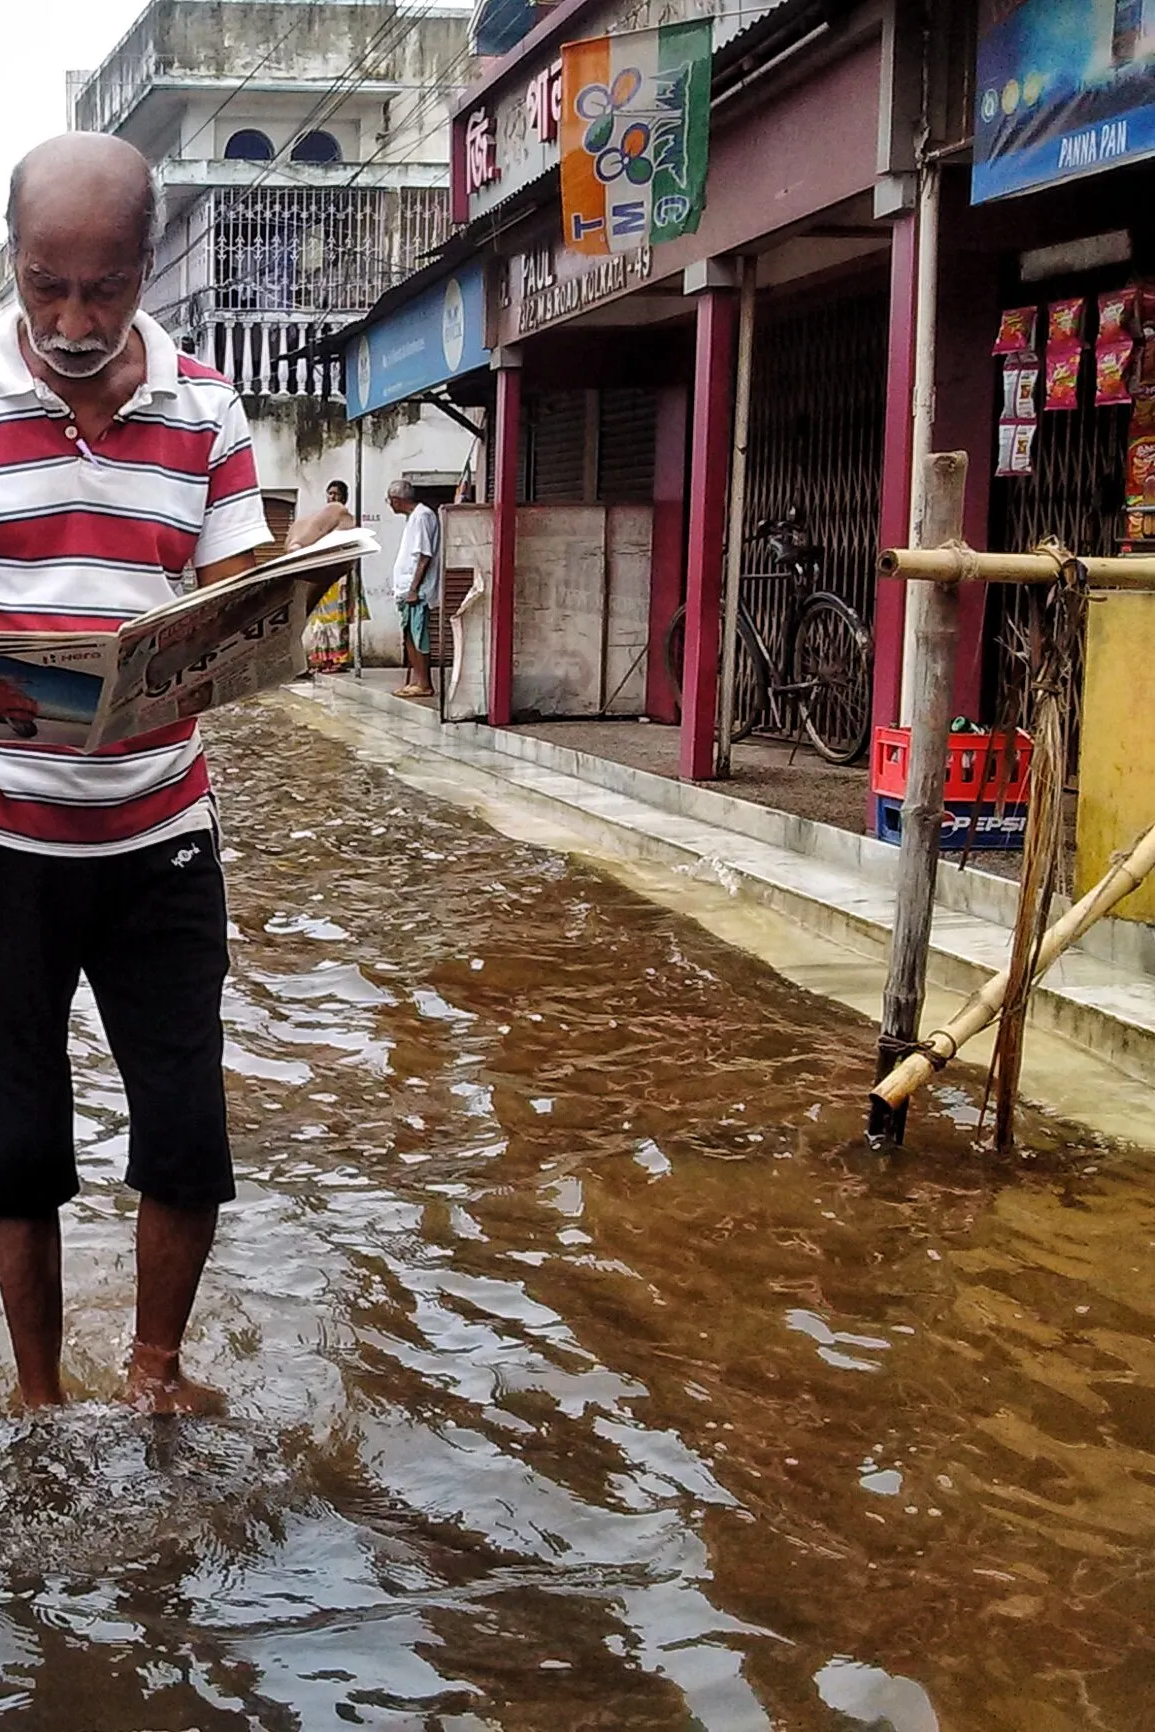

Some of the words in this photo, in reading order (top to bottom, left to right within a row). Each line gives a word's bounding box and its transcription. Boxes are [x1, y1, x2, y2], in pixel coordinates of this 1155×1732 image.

[1058, 129, 1097, 169] PANNA
[1099, 120, 1127, 161] PAN
[520, 250, 554, 300] PAUL
[581, 255, 625, 304] KOLKATA
[951, 816, 1027, 832] PEPSI
